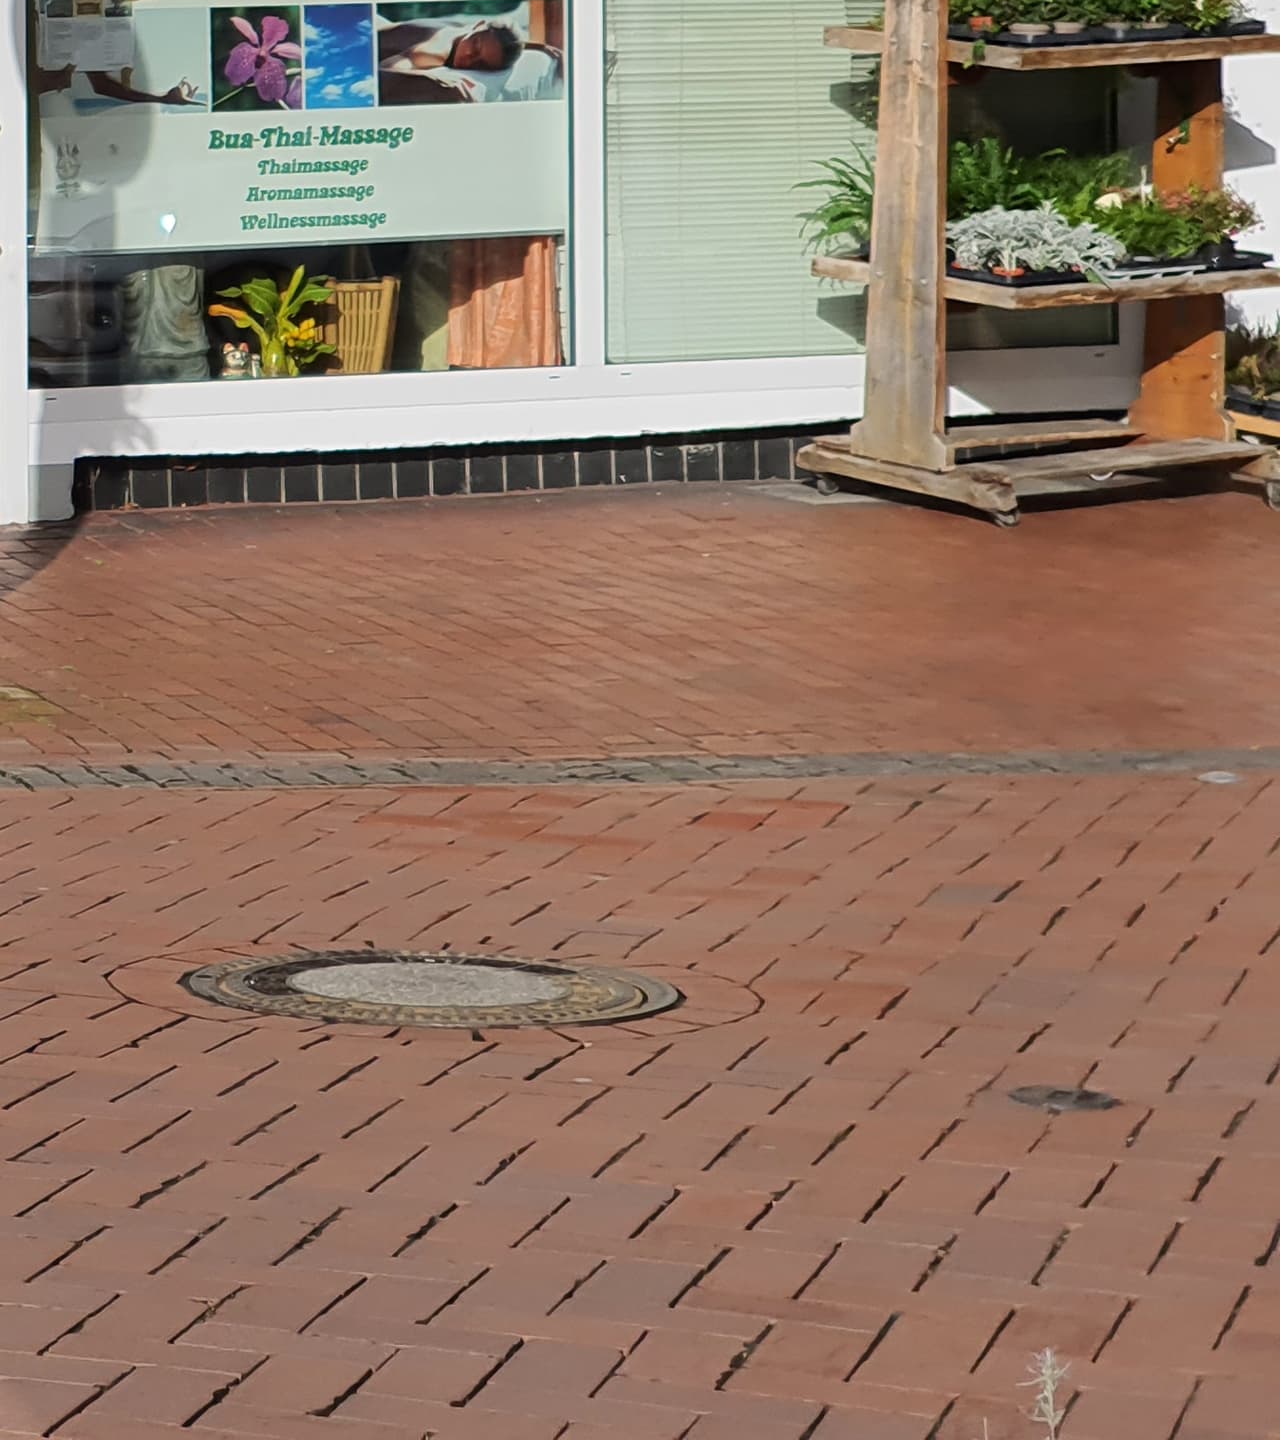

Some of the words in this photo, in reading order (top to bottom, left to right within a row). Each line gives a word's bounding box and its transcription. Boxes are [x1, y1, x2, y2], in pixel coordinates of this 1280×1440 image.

[208, 125, 414, 150] Bua-Thai-Massage
[256, 158, 369, 176] Thaimassage
[245, 184, 375, 202] Aromamassage
[239, 211, 387, 230] Wellnessmassage
